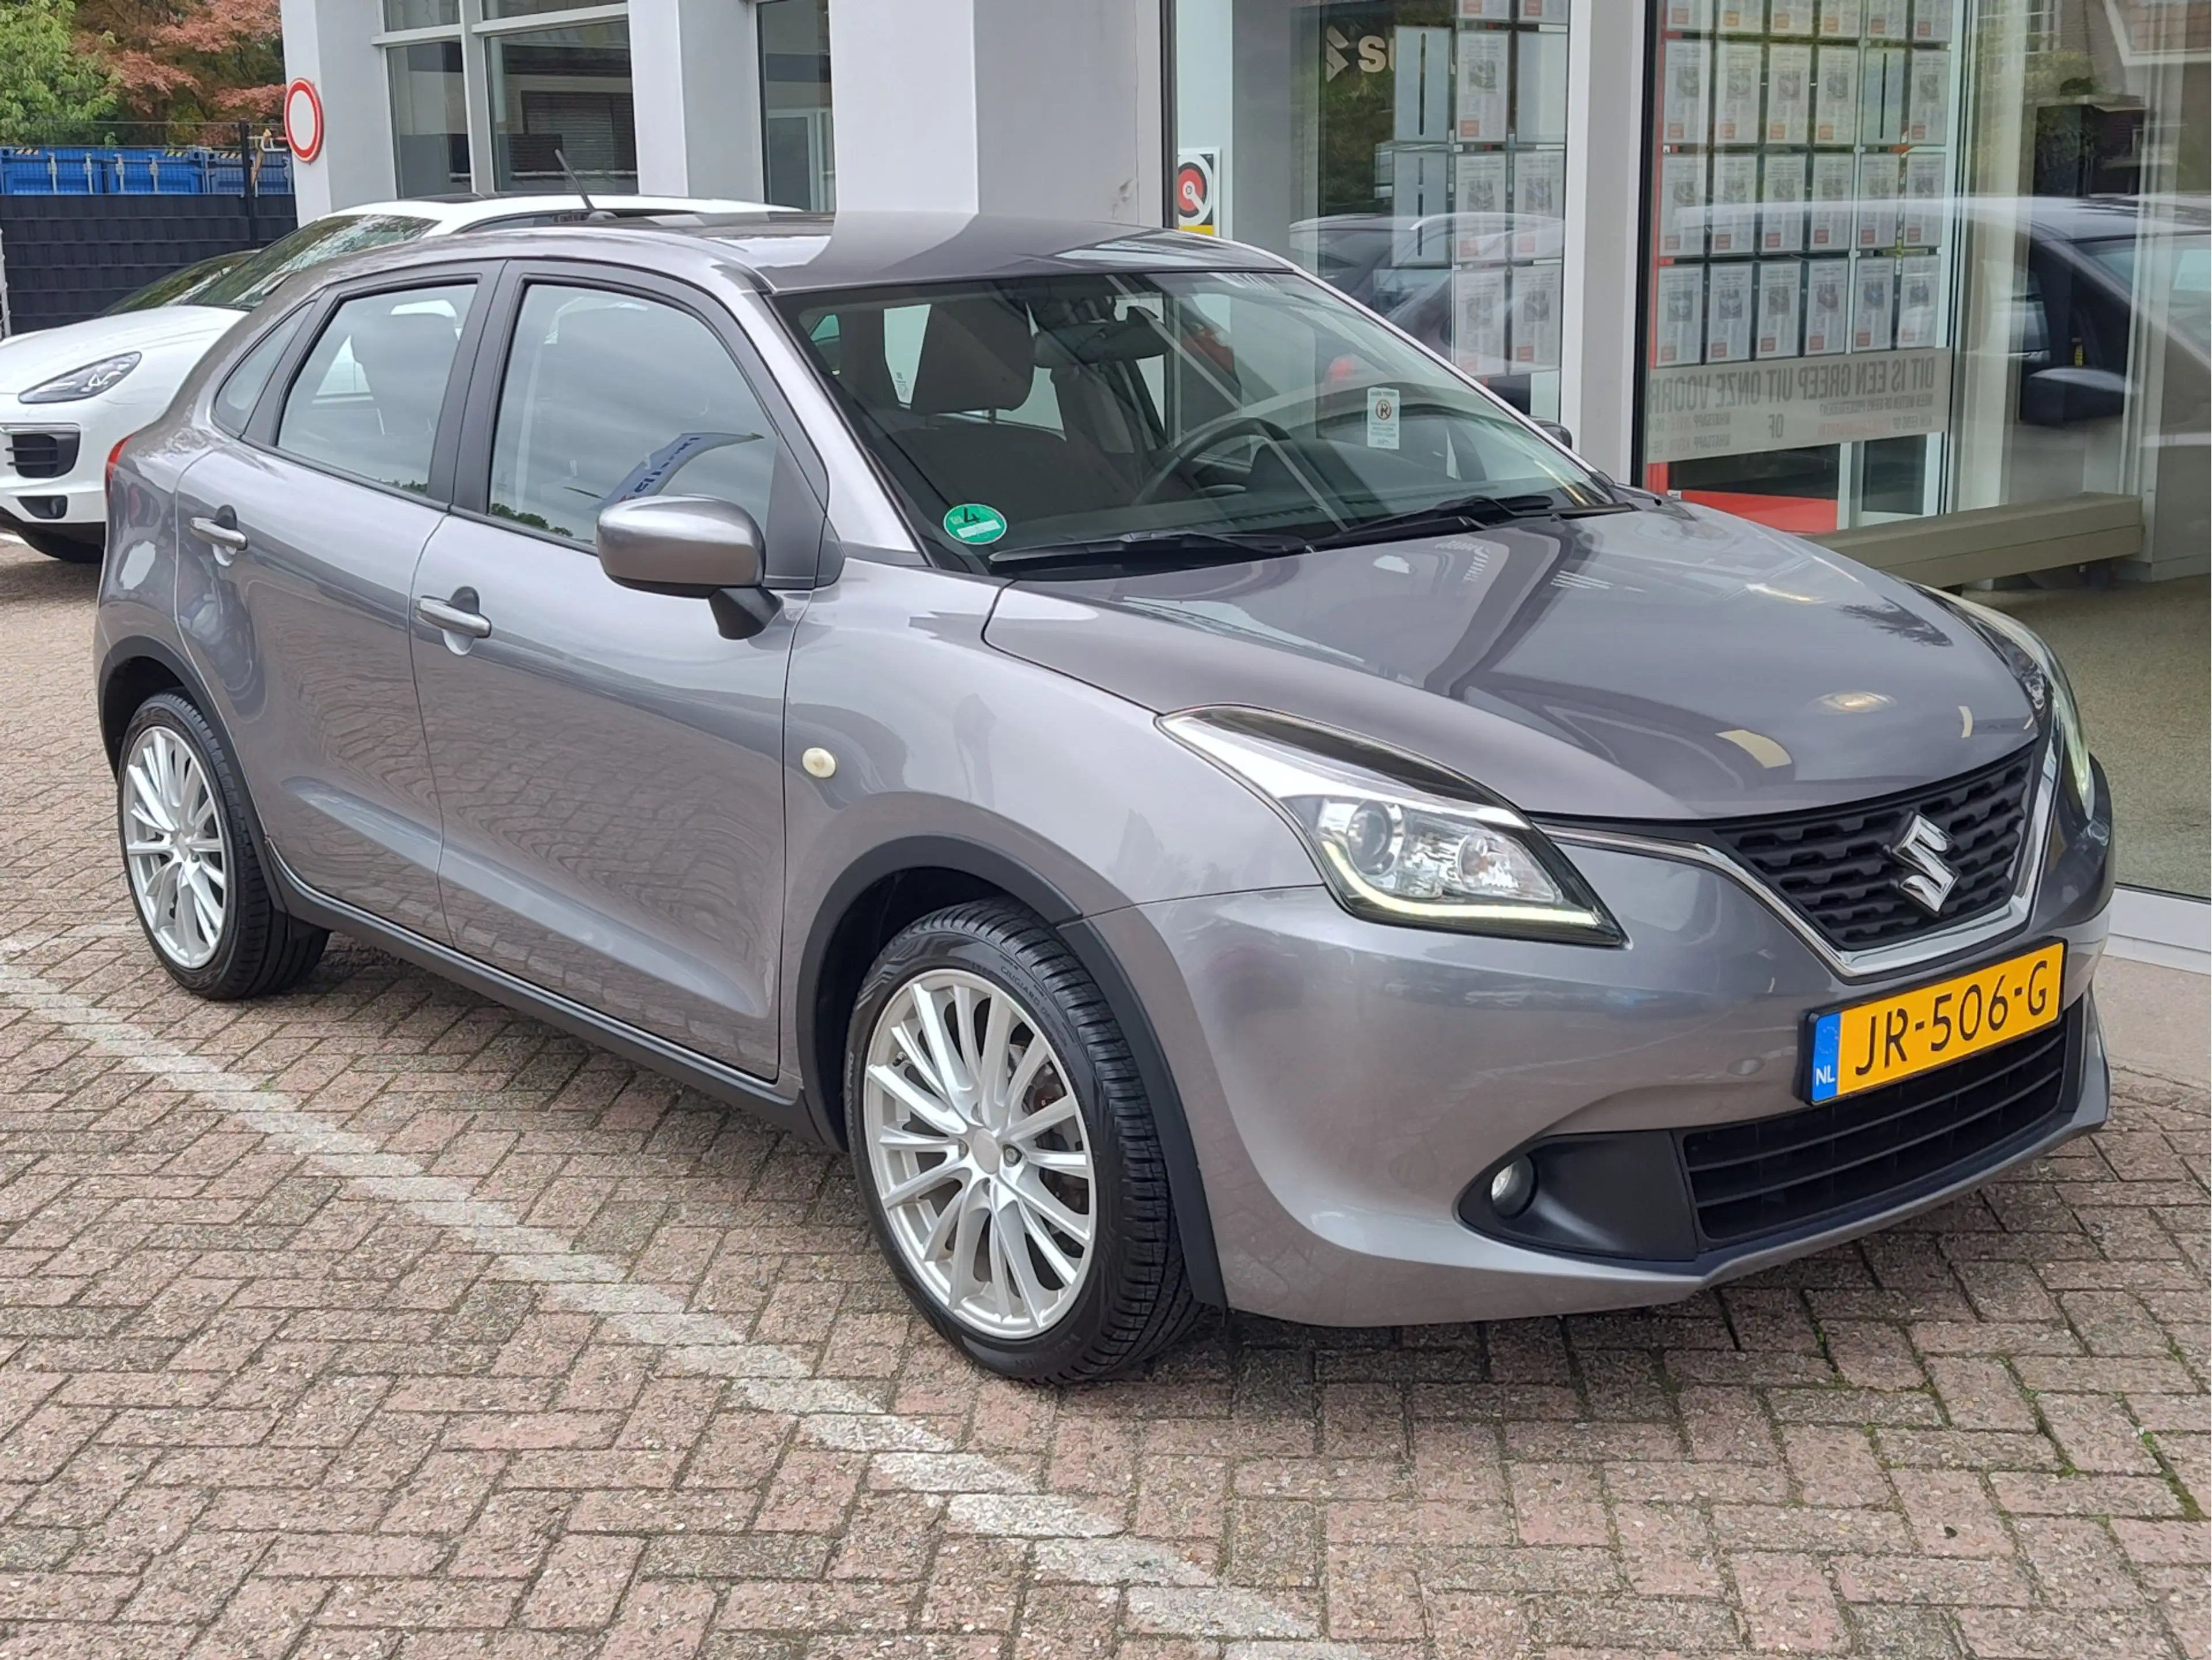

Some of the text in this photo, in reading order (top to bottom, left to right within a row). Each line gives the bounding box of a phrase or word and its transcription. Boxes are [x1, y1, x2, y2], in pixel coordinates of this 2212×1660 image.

[963, 507, 980, 523] 4
[1855, 960, 2048, 1076] JR-506-G
[1815, 1065, 1836, 1086] NL
